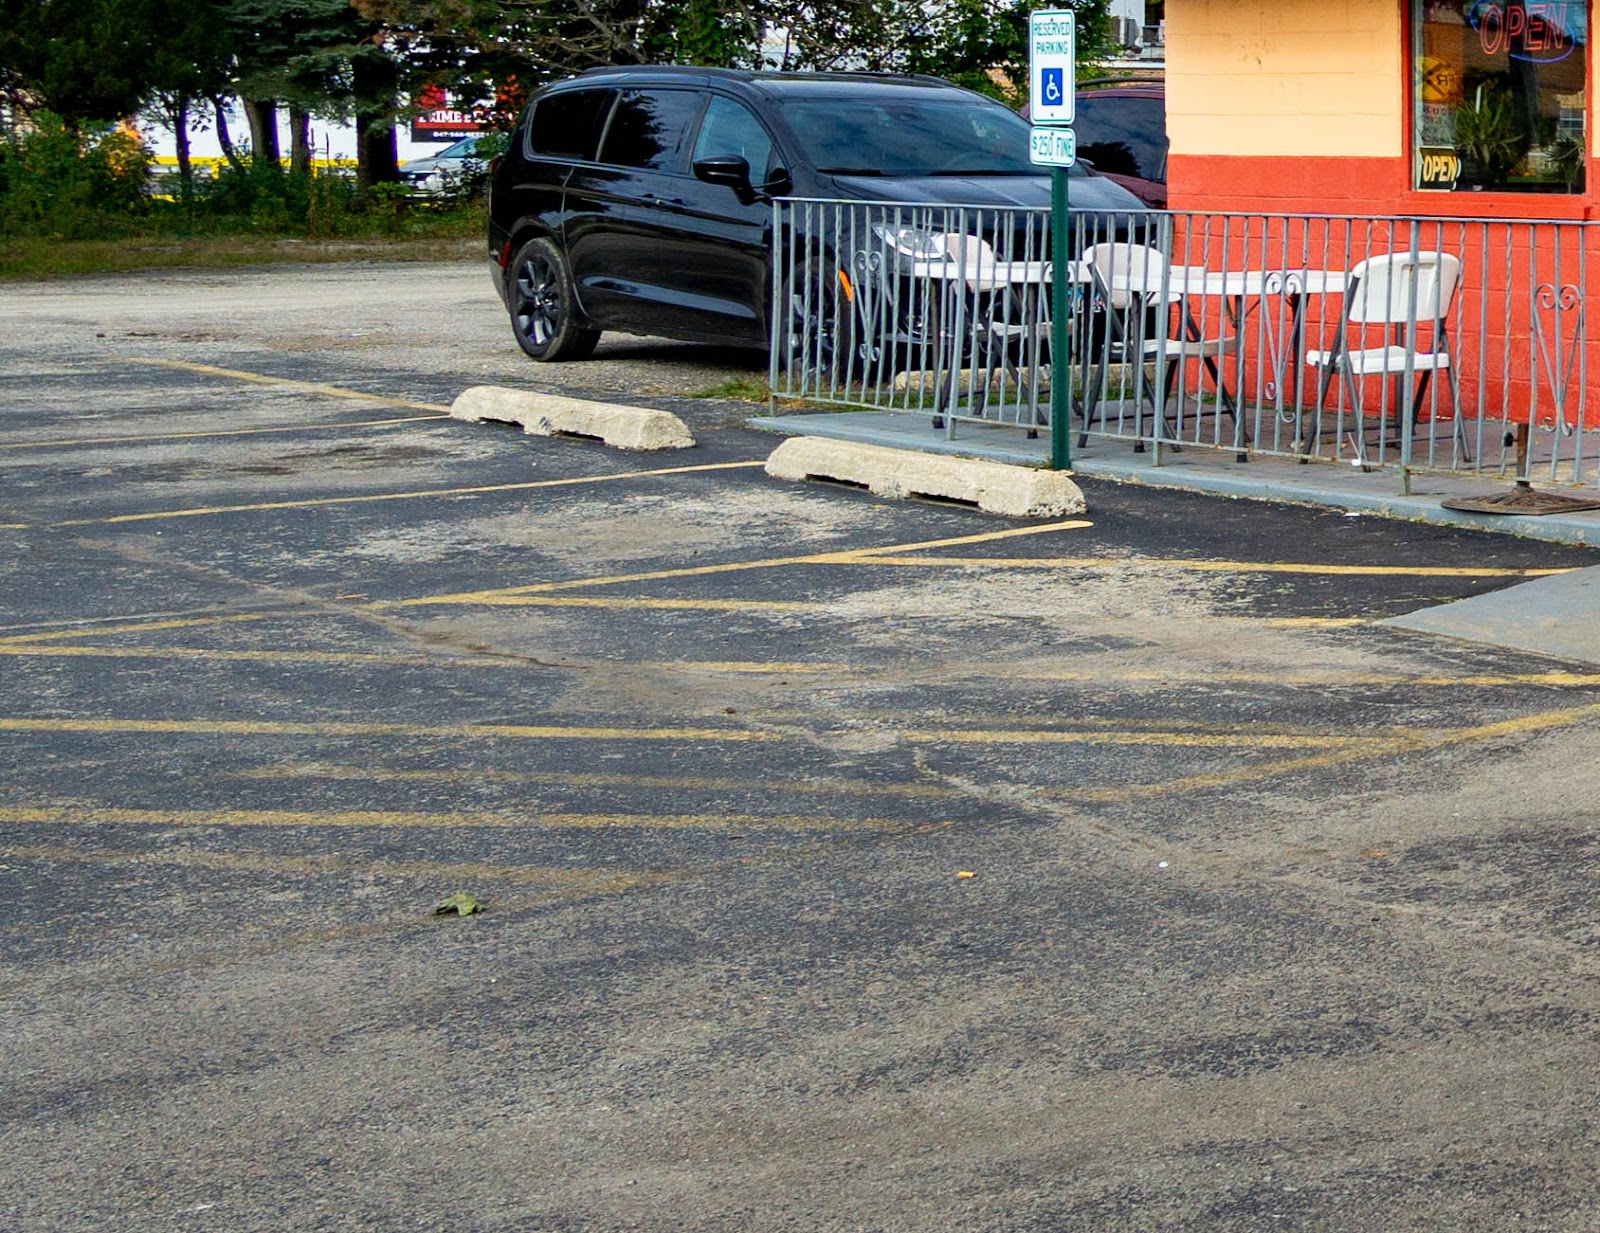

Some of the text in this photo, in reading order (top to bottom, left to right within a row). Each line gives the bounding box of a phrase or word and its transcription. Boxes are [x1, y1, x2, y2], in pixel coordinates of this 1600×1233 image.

[1033, 21, 1071, 37] RESERVED
[1479, 4, 1568, 55] OPEN
[1036, 40, 1069, 55] PARKING
[1056, 136, 1074, 159] FINE
[1423, 154, 1458, 183] OPEN
